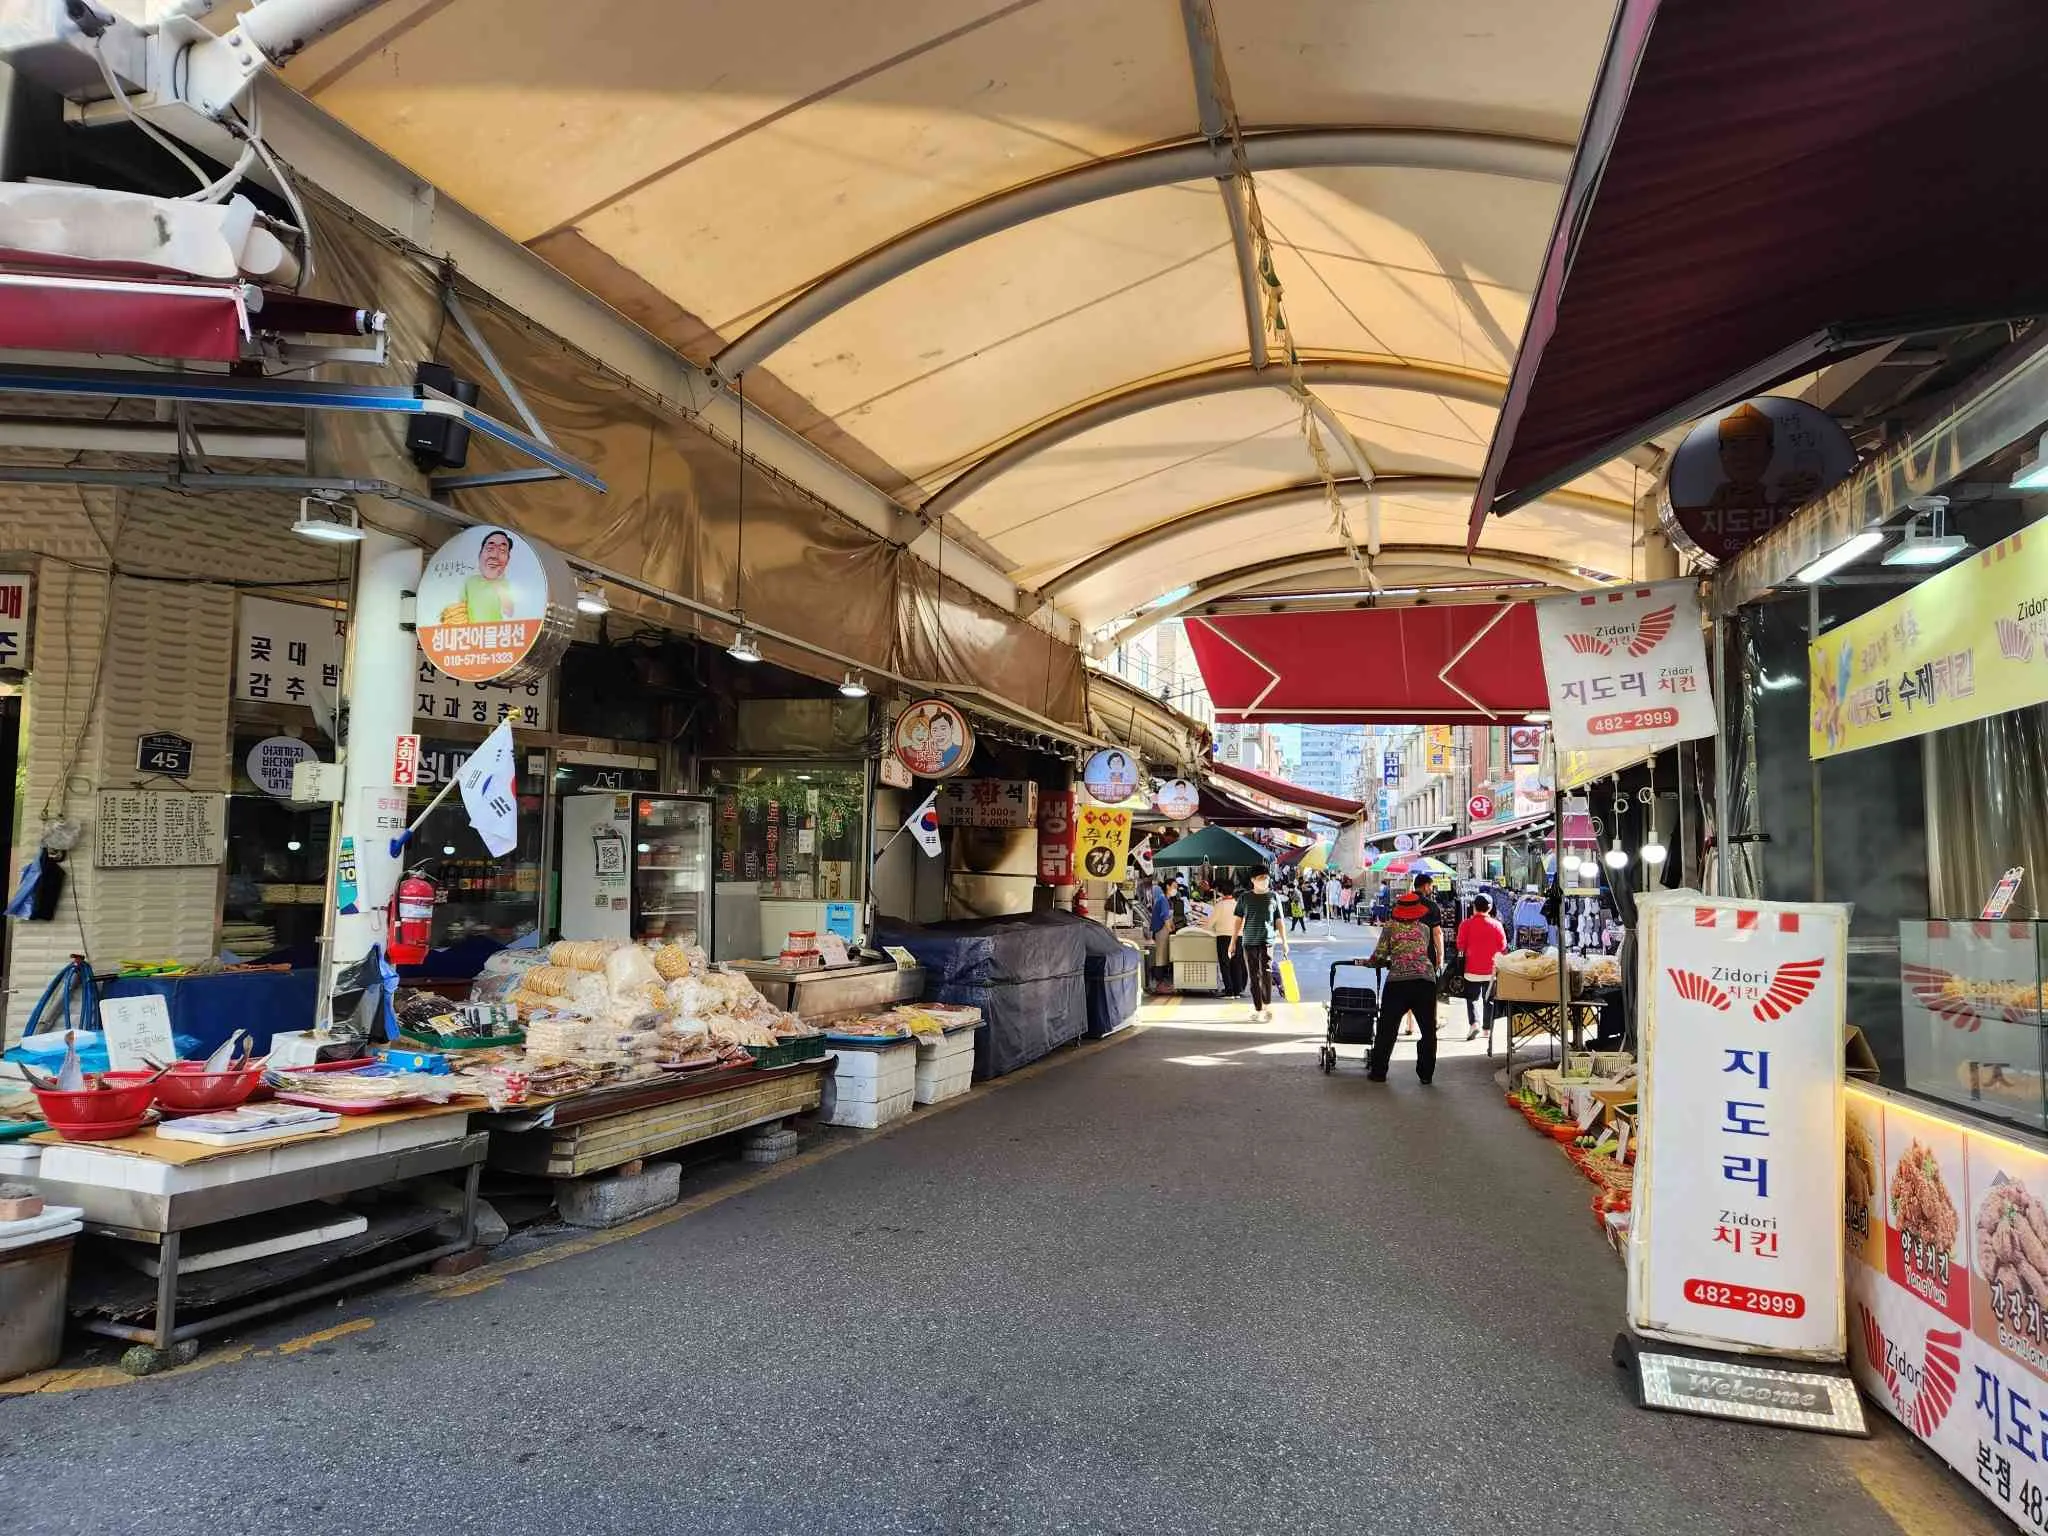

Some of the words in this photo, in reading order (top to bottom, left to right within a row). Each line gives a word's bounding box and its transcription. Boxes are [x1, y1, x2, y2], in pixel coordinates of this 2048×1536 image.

[432, 624, 524, 651] 성내건어물생선
[1596, 623, 1637, 636] Zidori
[1660, 666, 1693, 676] Zidori
[1561, 671, 1647, 706] 지도리
[1658, 676, 1697, 694] 치킨
[1594, 711, 1672, 731] 482-2999
[150, 751, 179, 769] 45
[263, 746, 303, 758] 어제까지
[396, 736, 418, 777] 소화기
[1471, 798, 1490, 815] 약
[1082, 827, 1122, 848] 즉석
[1089, 849, 1111, 875] 김
[1711, 966, 1769, 984] Zidori
[1728, 986, 1758, 1000] 치킨
[1722, 1049, 1771, 1198] 지도리
[1720, 1209, 1777, 1229] Zidori
[1713, 1226, 1779, 1258] 치킨
[1901, 1229, 1949, 1287] 양념치킨
[1693, 1283, 1796, 1314] 482-2999
[1886, 1338, 1926, 1392] Zidori
[1688, 1372, 1817, 1407] Welcome
[1976, 1438, 2011, 1503] 본점
